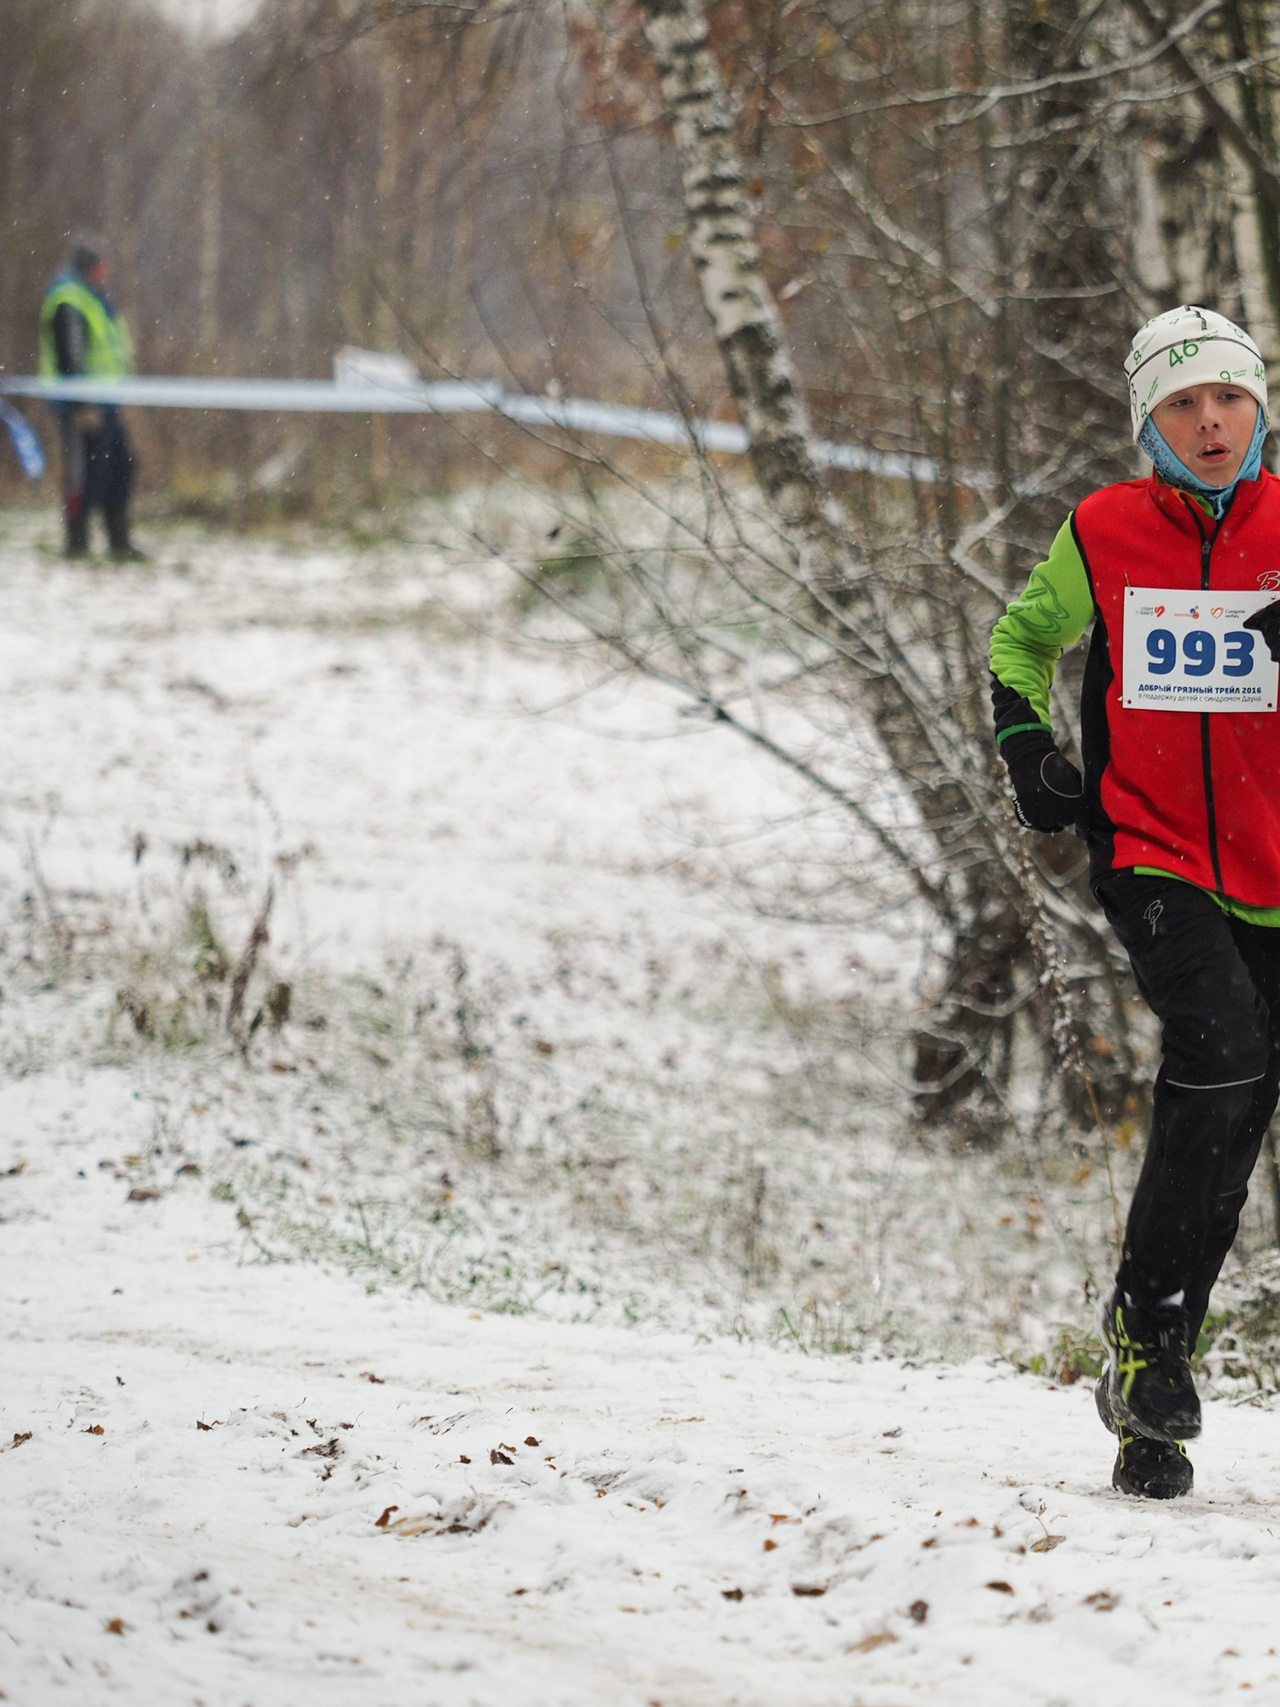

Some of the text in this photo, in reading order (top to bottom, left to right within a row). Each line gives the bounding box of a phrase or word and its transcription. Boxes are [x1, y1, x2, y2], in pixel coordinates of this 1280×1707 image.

[1146, 628, 1255, 677] 993
[1138, 684, 1262, 694] ДОБРЫЙ ГРЯЗНЫЙ ТРЕЙЛ 2016
[1143, 693, 1177, 702] поддержку
